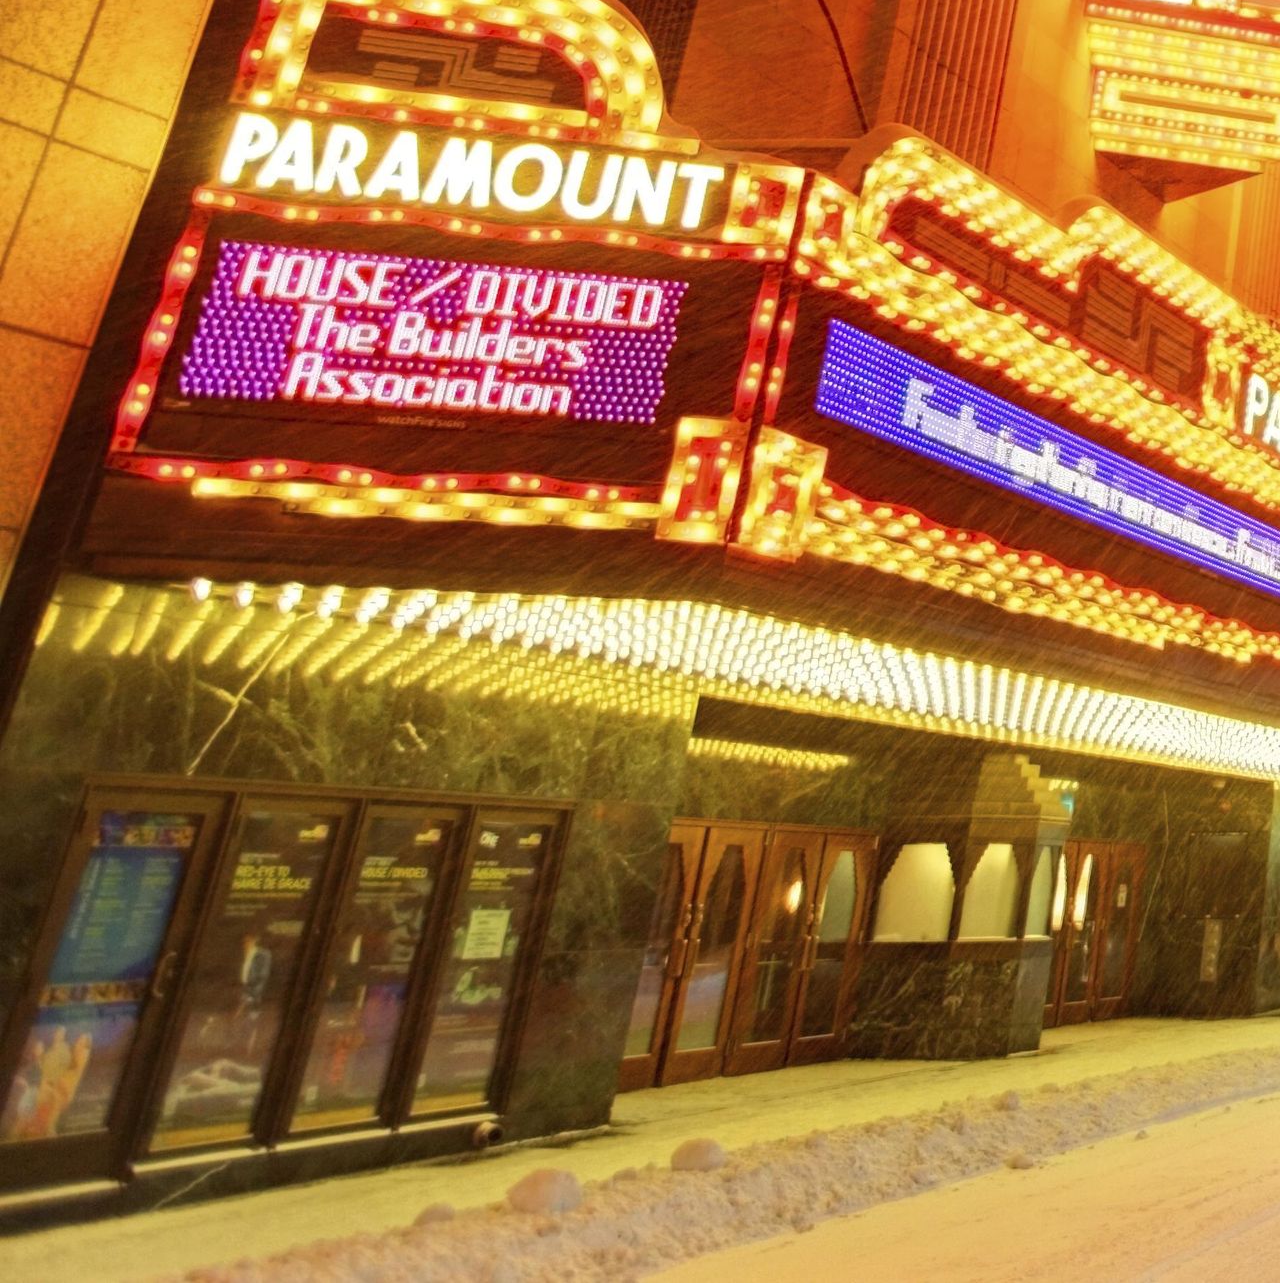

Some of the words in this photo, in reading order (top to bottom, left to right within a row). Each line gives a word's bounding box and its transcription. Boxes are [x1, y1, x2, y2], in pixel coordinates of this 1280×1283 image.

[220, 112, 725, 229] PARAMOUNT
[237, 251, 406, 308] HOUSE
[464, 270, 664, 328] DIVIDED
[292, 303, 381, 355] The
[387, 310, 593, 369] Builders
[281, 351, 572, 415] Association
